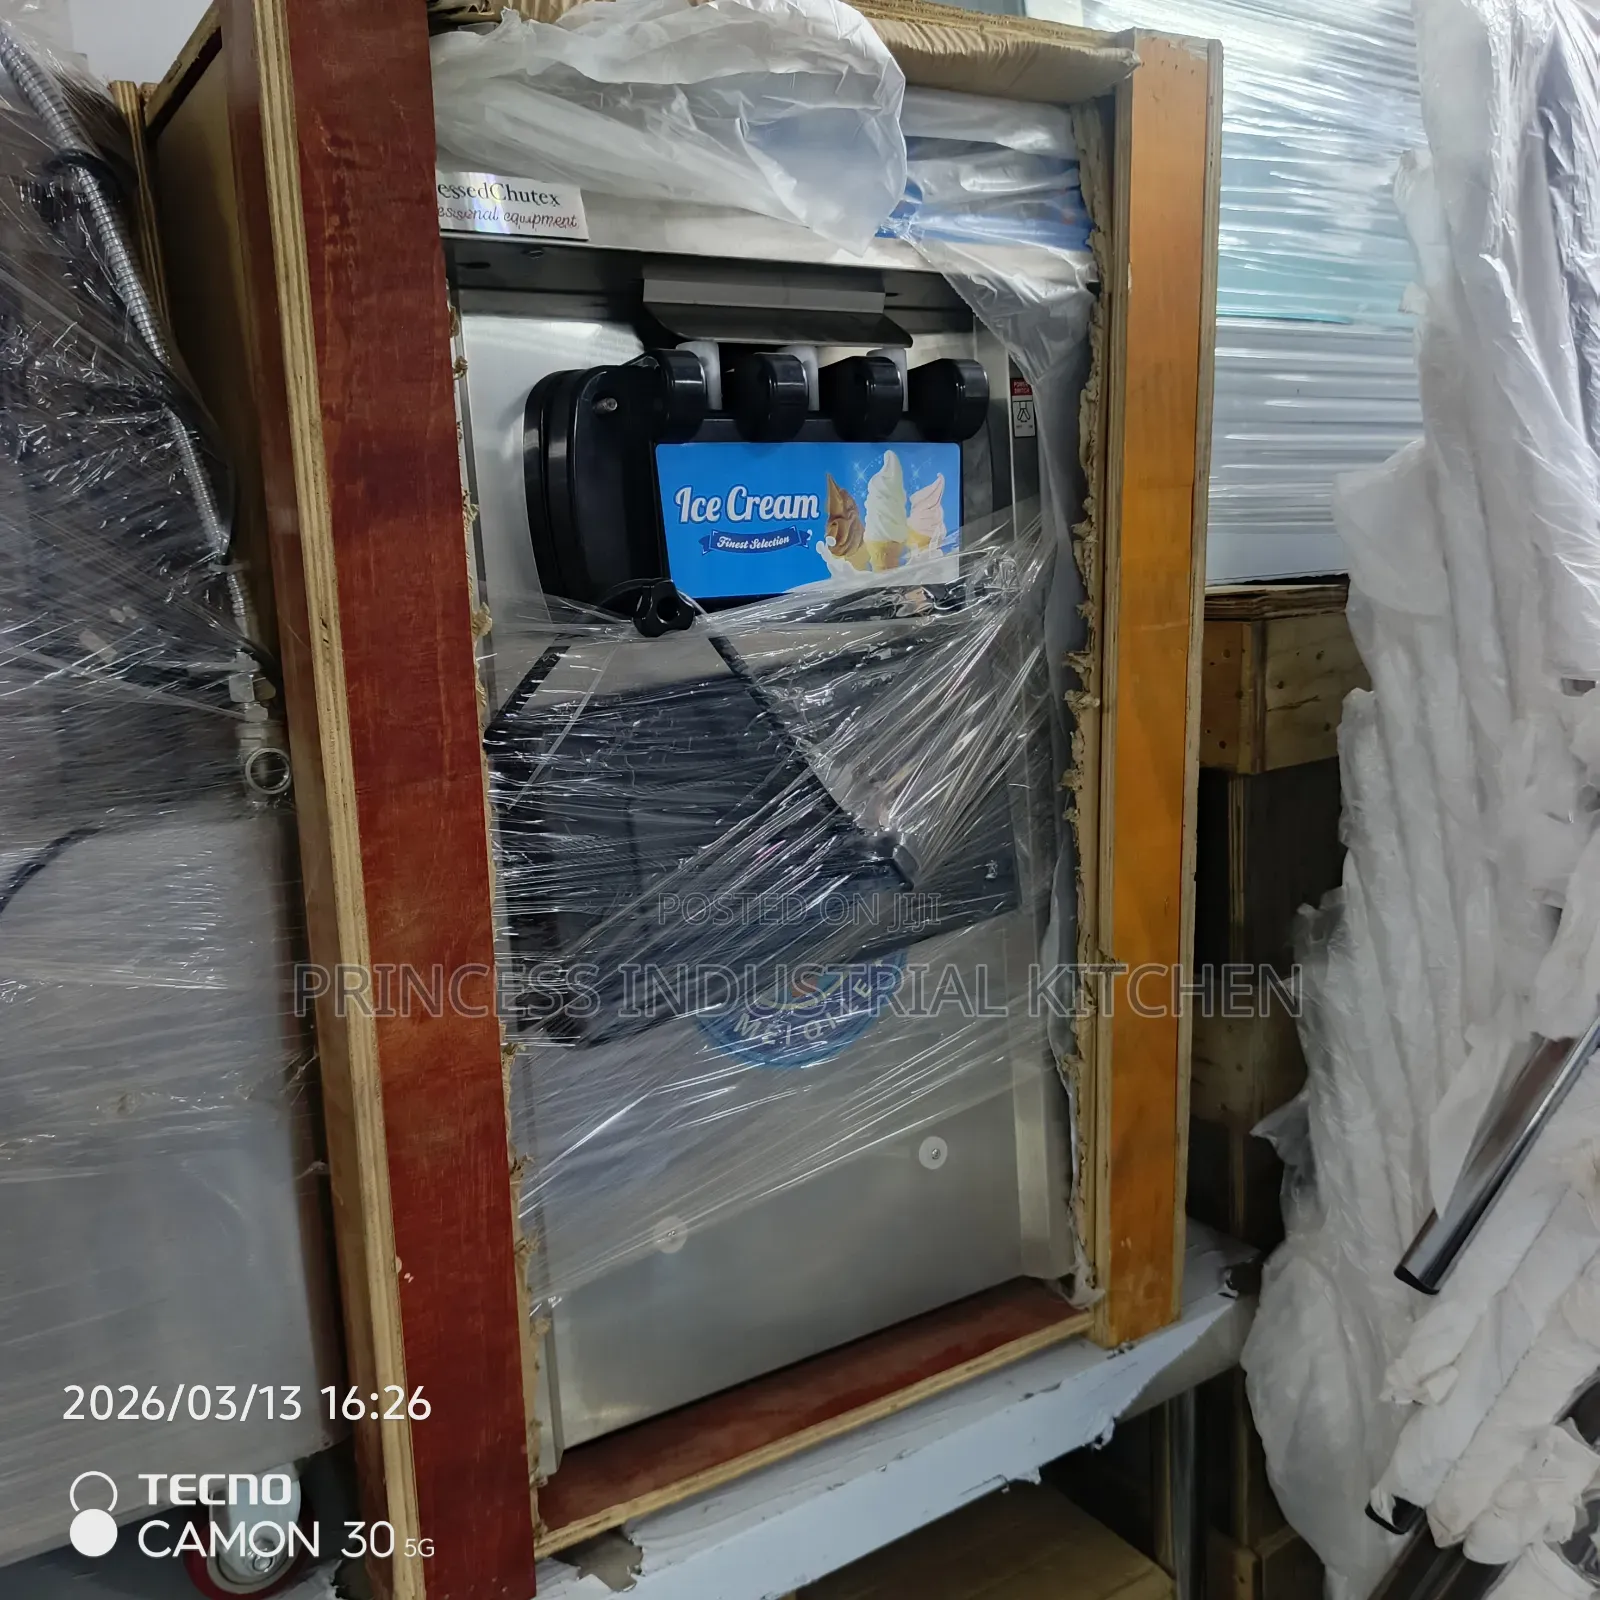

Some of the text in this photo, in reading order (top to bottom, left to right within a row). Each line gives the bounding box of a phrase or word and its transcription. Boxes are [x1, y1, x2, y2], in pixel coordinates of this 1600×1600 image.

[438, 182, 560, 207] essedChutex
[438, 206, 578, 231] essional equipment
[674, 485, 819, 523] Ice Cream
[716, 535, 790, 549] Finest Selection
